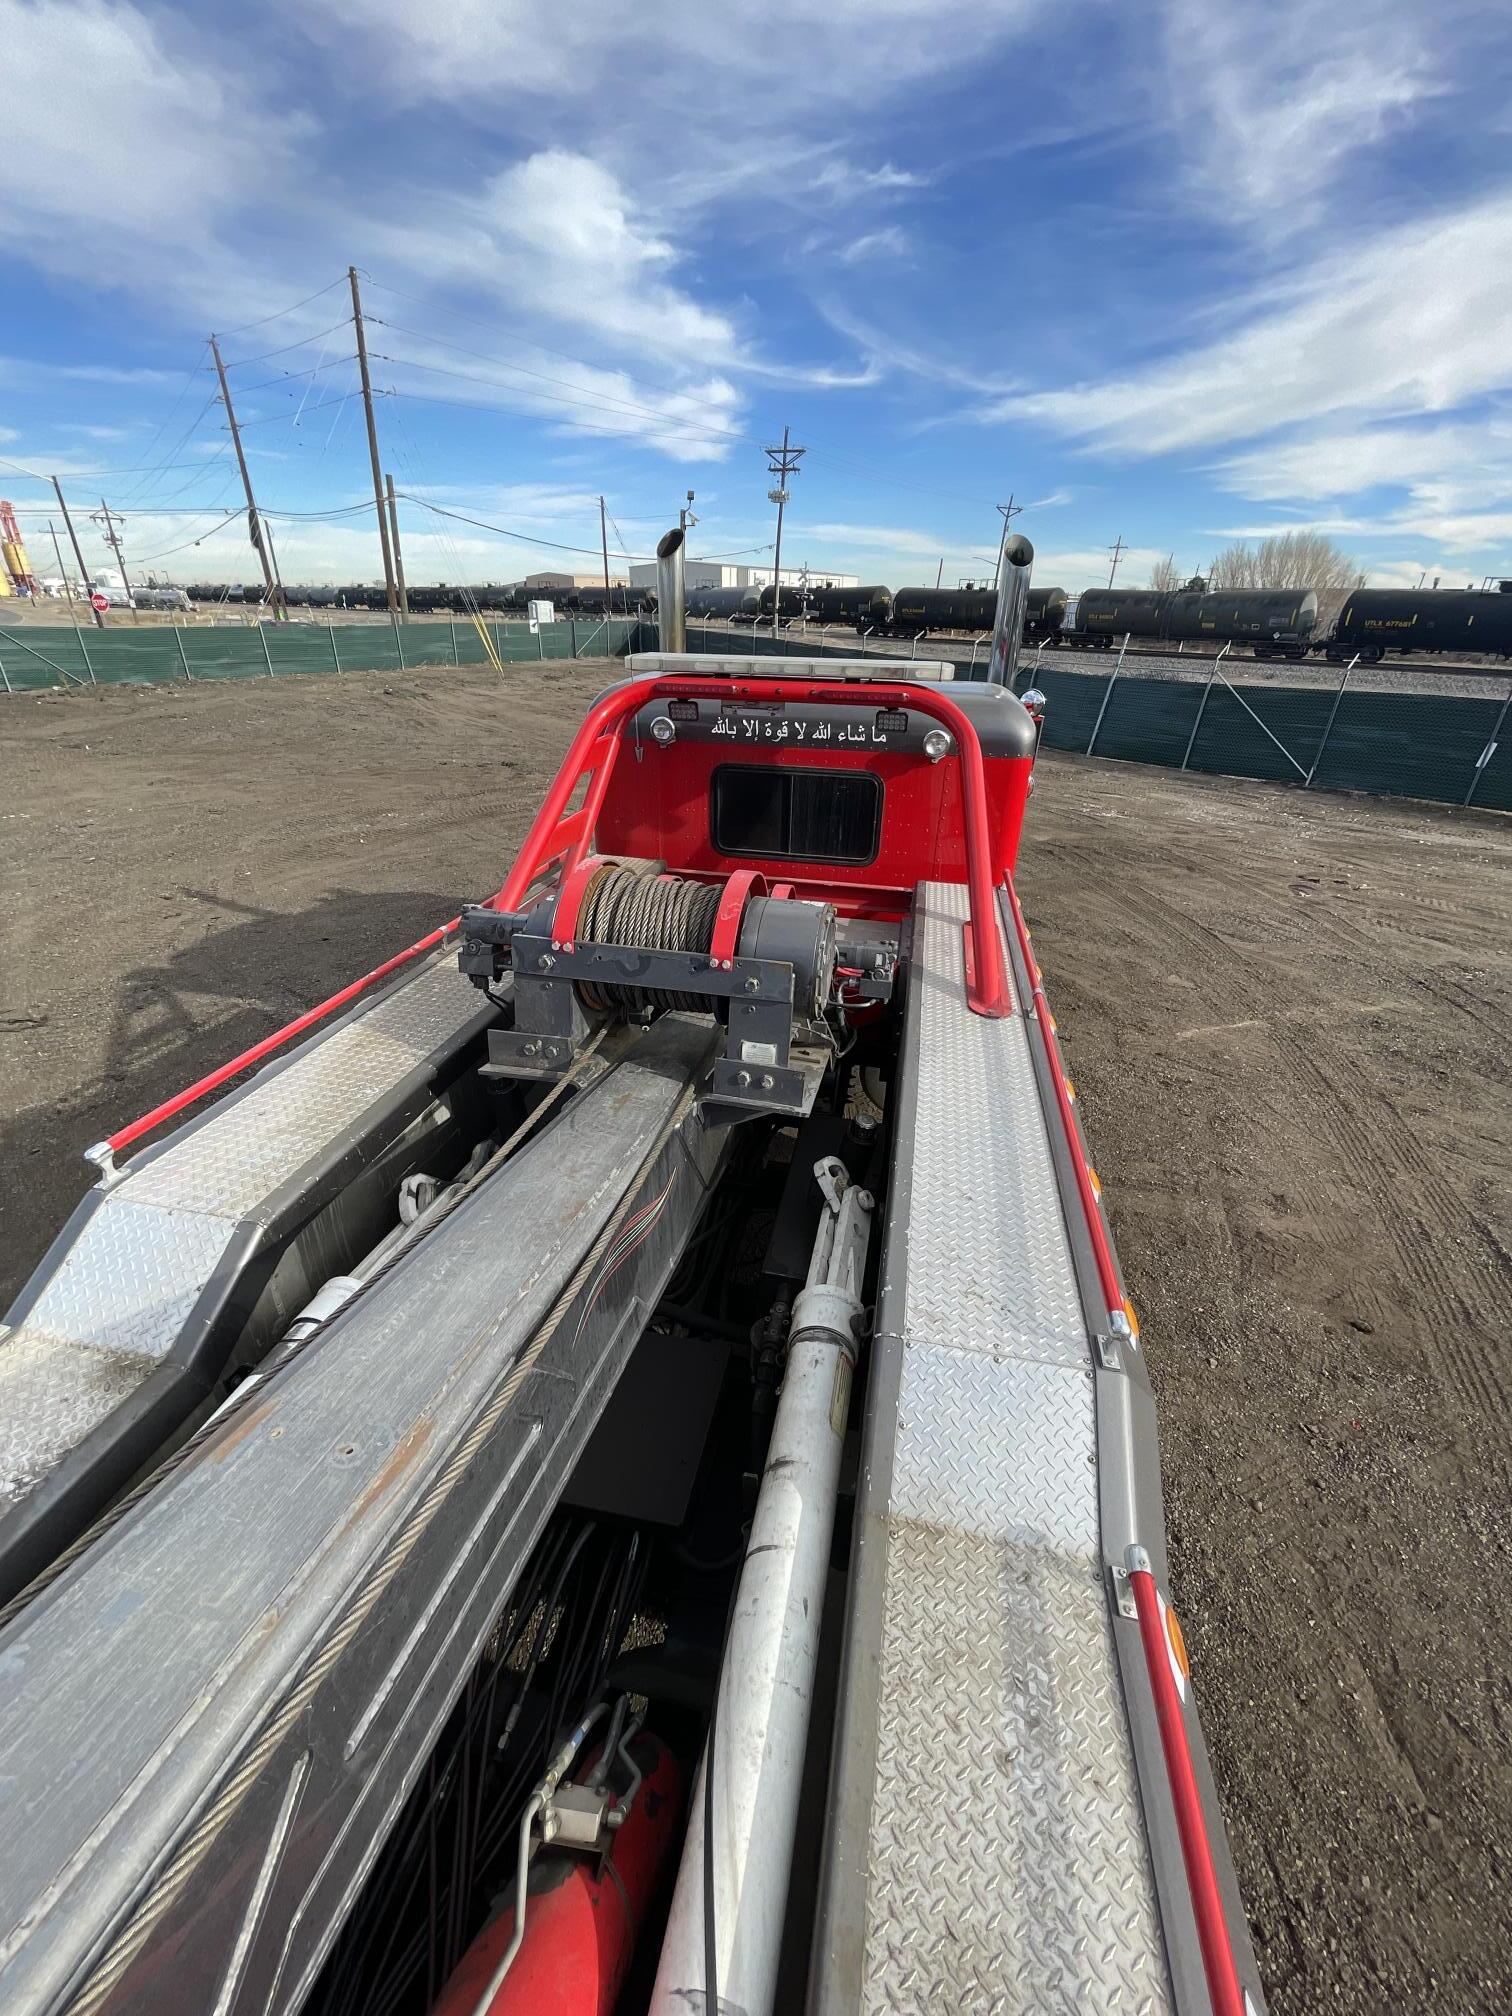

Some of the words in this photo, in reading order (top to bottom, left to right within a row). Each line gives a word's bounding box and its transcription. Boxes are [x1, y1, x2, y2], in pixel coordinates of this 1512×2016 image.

[711, 716, 737, 739] بالله
[742, 719, 759, 741] إلا
[764, 720, 789, 742] قوة
[794, 721, 807, 740] لا
[812, 722, 831, 740] الله
[837, 724, 866, 742] شاء
[871, 725, 887, 743] ما
